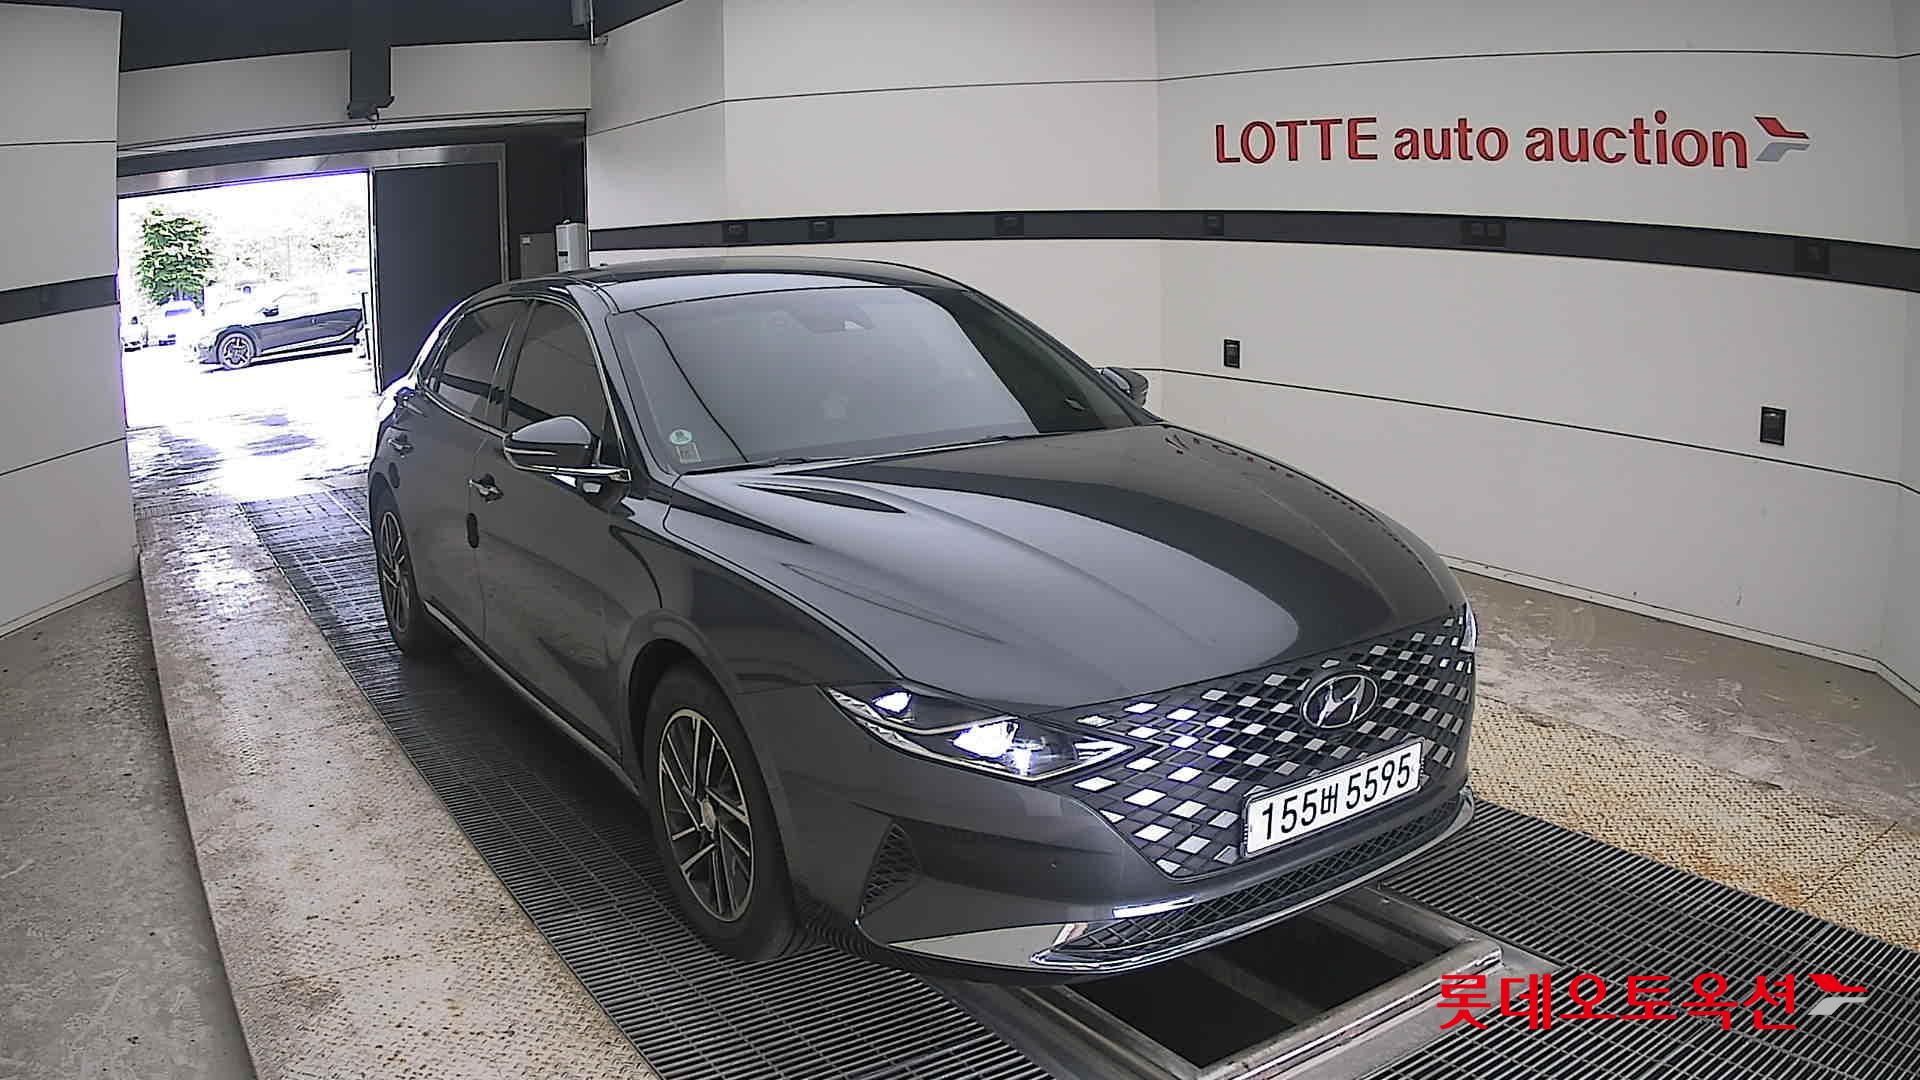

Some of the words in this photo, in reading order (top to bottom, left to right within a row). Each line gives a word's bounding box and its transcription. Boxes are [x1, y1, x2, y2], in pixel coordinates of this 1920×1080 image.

[1215, 117, 1377, 163] LOTTE
[1393, 117, 1509, 161] auto
[1525, 110, 1748, 168] auction
[1262, 782, 1339, 840] 155버
[1346, 752, 1411, 810] 5595
